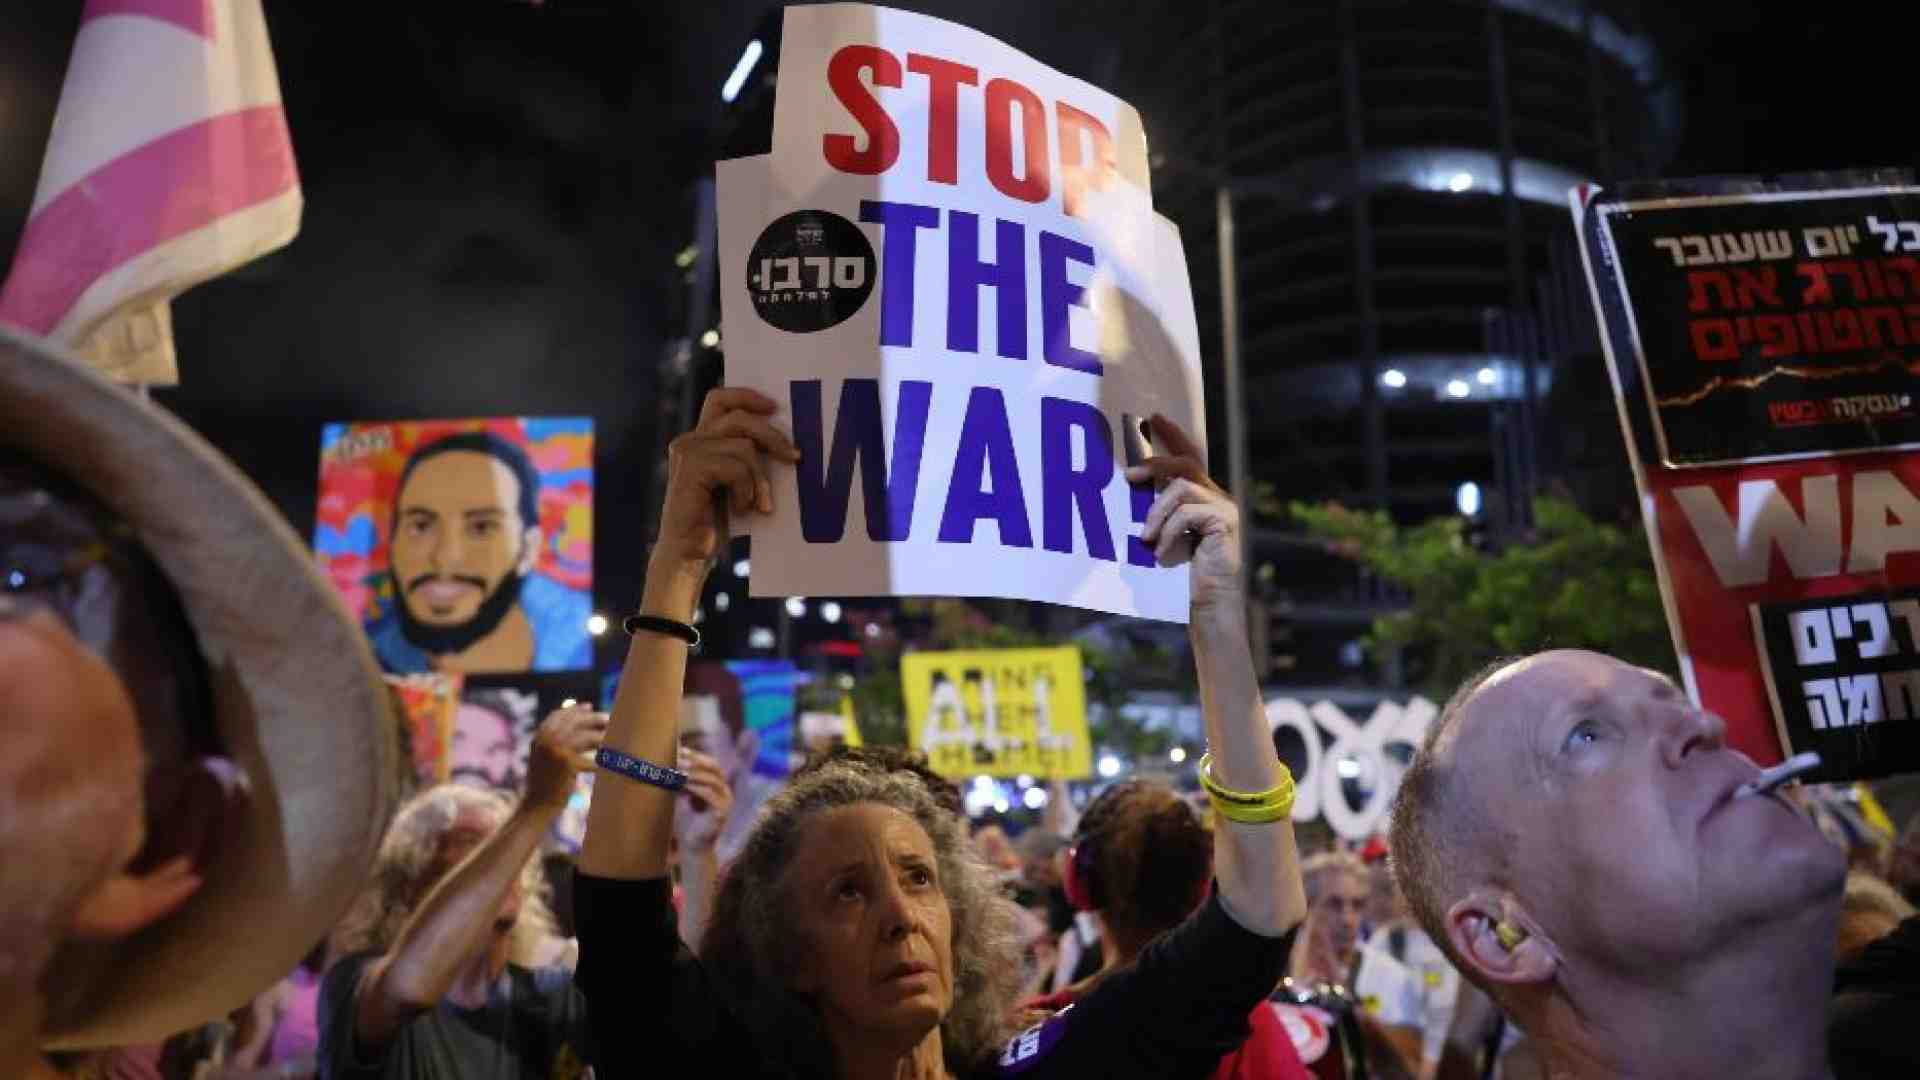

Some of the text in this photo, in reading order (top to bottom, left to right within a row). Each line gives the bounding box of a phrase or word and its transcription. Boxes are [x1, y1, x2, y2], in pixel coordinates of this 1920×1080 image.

[822, 44, 1114, 217] STOP
[1654, 229, 1793, 267] שעובר
[1803, 224, 1860, 258] יום
[760, 256, 866, 291] סרבו
[859, 200, 1104, 376] THE
[1687, 265, 1783, 312] את
[790, 378, 1157, 568] WAR!
